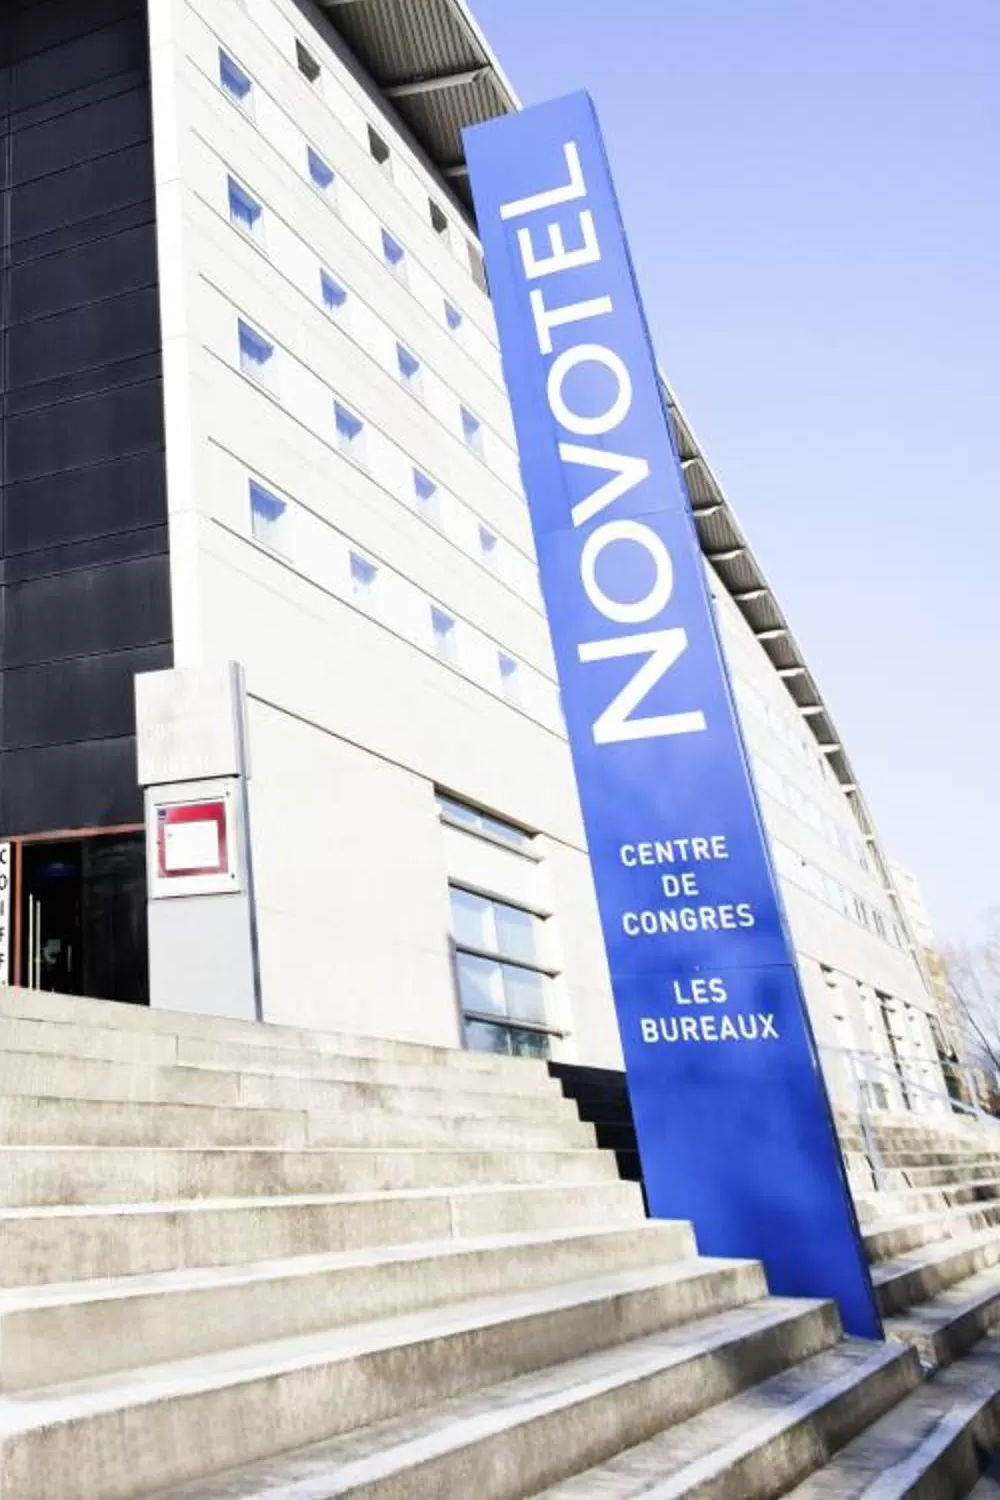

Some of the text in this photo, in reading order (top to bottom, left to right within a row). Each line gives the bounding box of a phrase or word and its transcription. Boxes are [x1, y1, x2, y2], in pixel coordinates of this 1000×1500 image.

[500, 141, 708, 746] NOVOTEL
[619, 835, 729, 868] CENTRE
[661, 872, 700, 898] DE
[622, 903, 755, 936] CONGRES
[673, 978, 728, 1005] LES
[640, 1013, 779, 1043] BUREAUX
